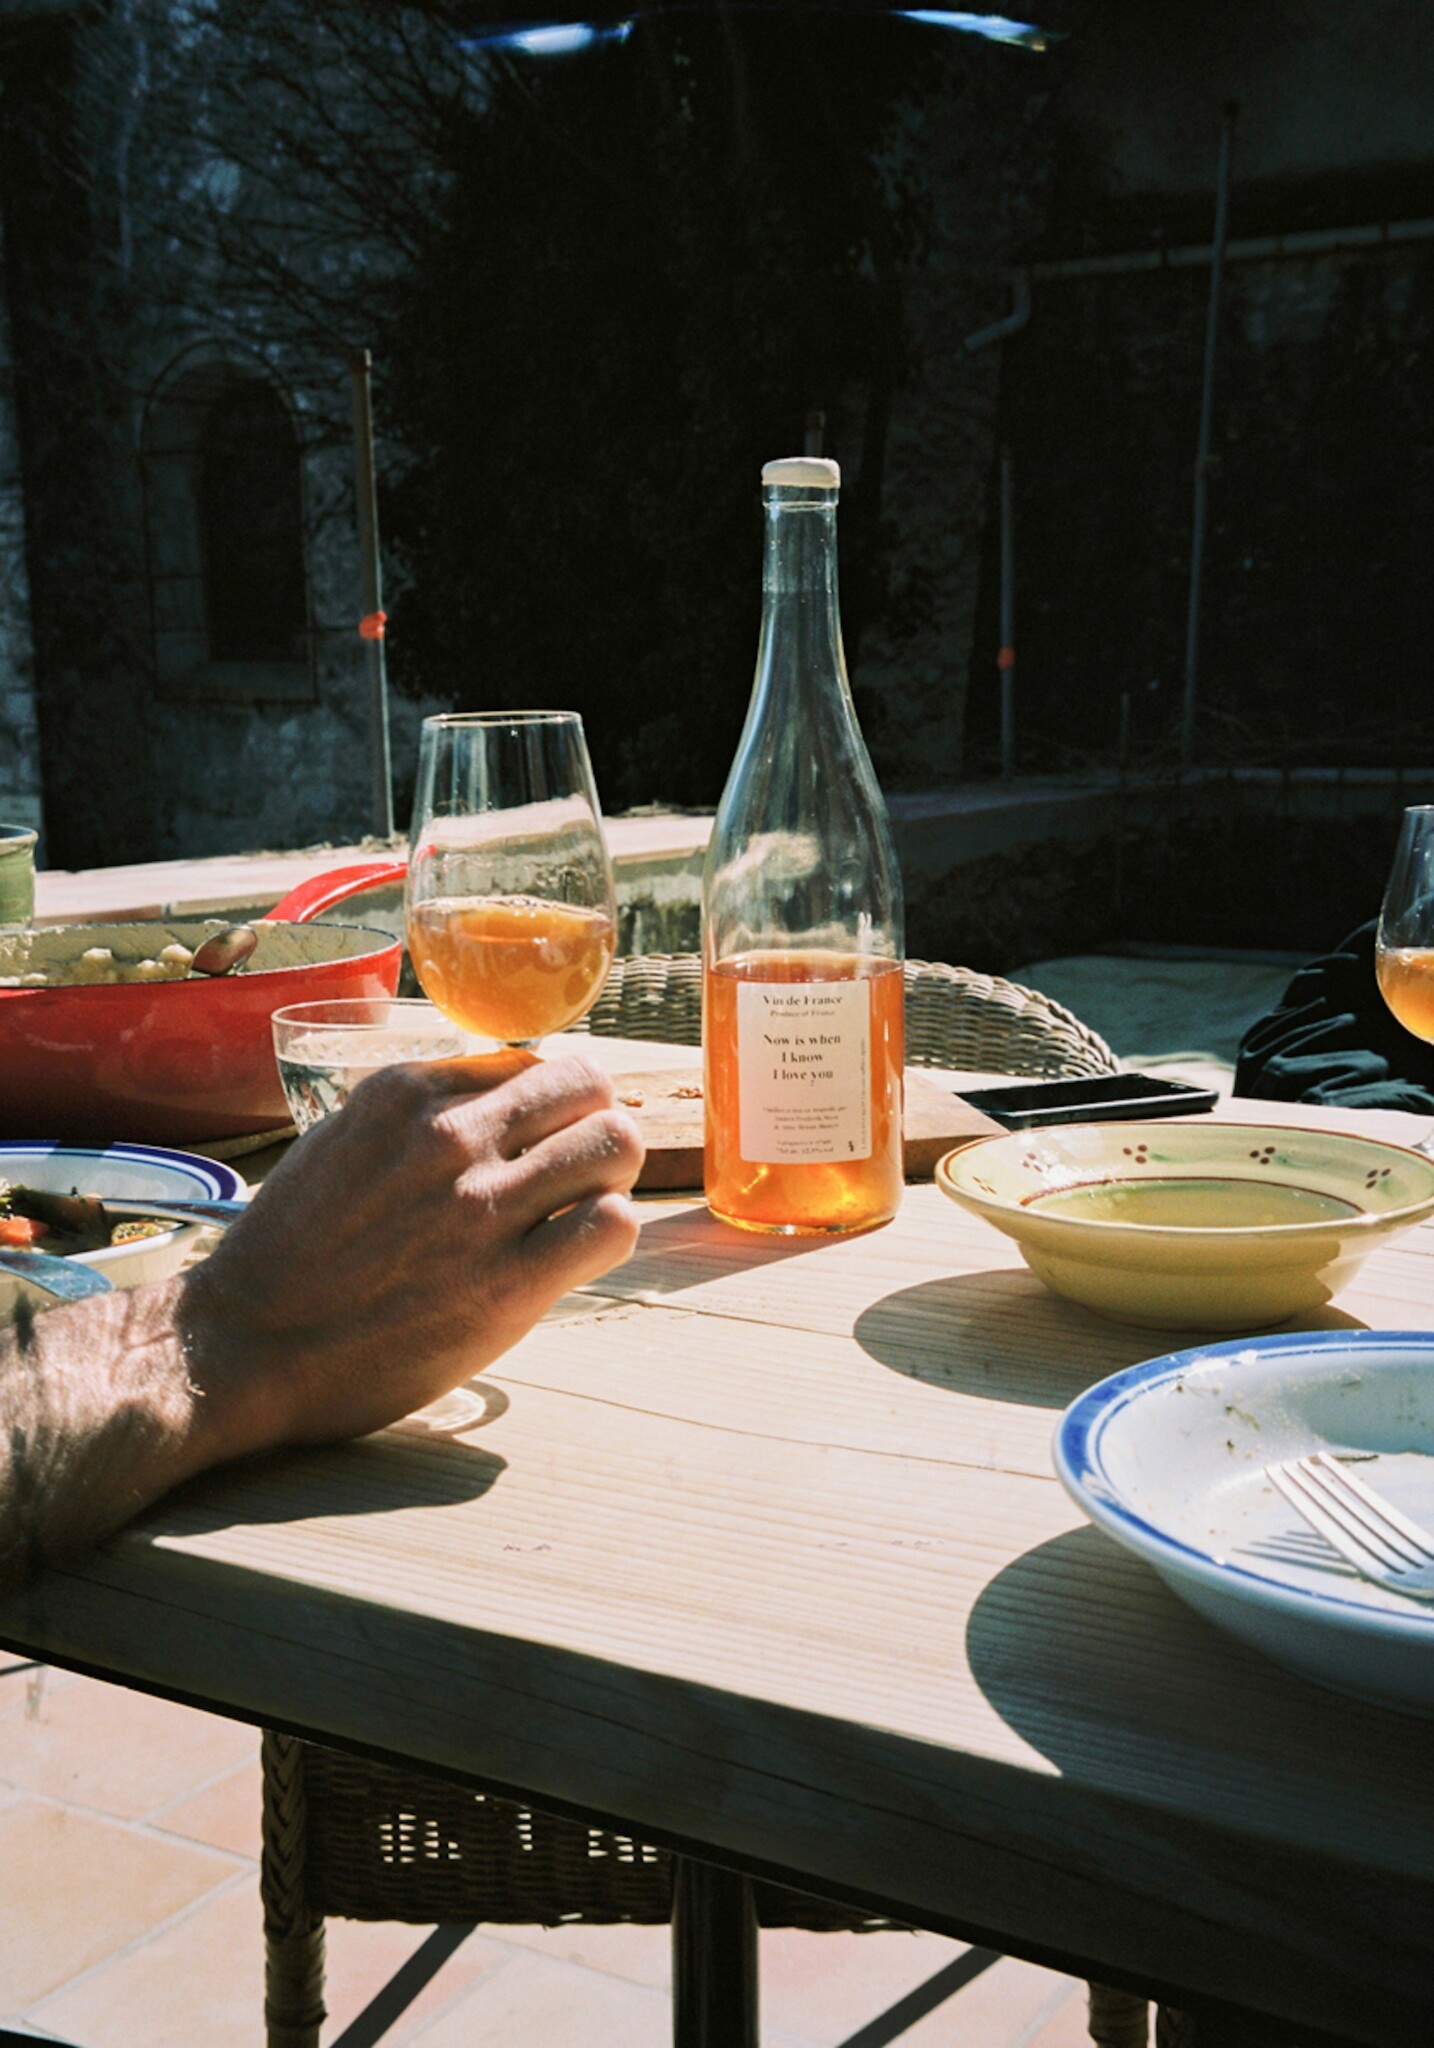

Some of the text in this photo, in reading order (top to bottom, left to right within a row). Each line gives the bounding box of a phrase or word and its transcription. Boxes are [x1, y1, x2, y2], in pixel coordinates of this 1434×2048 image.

[763, 995, 842, 1006] Vin de France
[763, 1034, 841, 1045] Now is when
[791, 1052, 823, 1063] know
[781, 1069, 807, 1080] love
[810, 1070, 833, 1085] you
